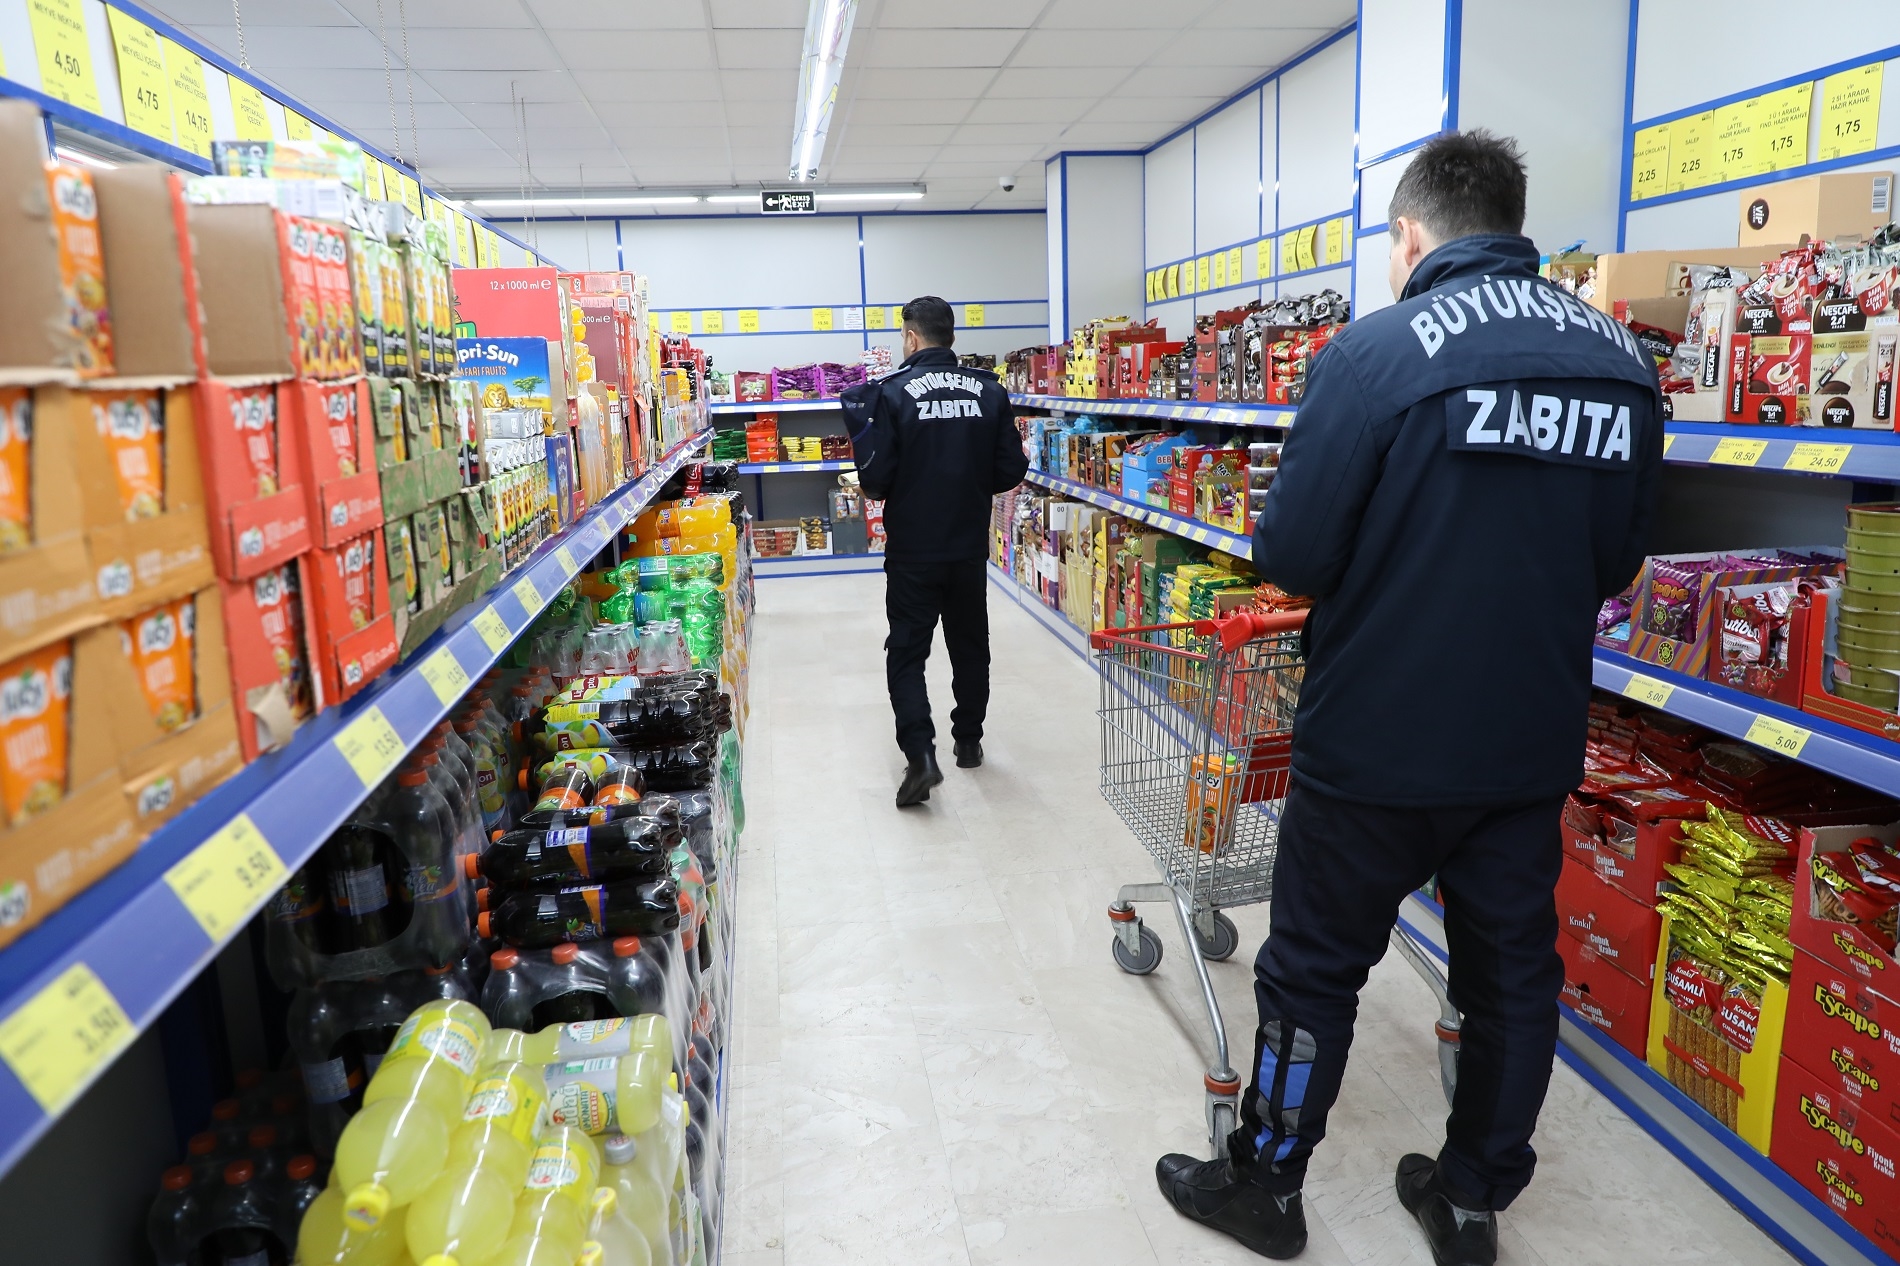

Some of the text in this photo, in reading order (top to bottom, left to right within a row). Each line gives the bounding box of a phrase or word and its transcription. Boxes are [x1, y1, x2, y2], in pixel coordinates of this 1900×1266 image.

[54, 49, 81, 77] 4,50
[137, 86, 159, 110] 4,75
[1847, 87, 1870, 98] ARADA
[1781, 106, 1801, 116] ARADA
[1830, 95, 1871, 111] HAZIR KAHVE
[185, 110, 208, 133] 14,75
[1727, 122, 1743, 131] LATTE
[1773, 116, 1789, 126] HAZIR
[1789, 111, 1808, 121] KAHVE
[1733, 126, 1751, 137] KAHVE
[1835, 119, 1861, 138] 1,75
[1685, 136, 1700, 146] SALEP
[1770, 135, 1793, 153] 1,75
[1722, 147, 1744, 164] 1,75
[1681, 158, 1701, 175] 2,25
[1638, 168, 1656, 184] 2,25
[490, 280, 540, 291] 12 x 1000 ml
[904, 371, 984, 400] BÜYÜKŞEHİR
[916, 400, 983, 420] ZABITA
[1466, 389, 1631, 462] ZABITA
[1731, 451, 1756, 462] 18,50
[1809, 457, 1839, 468] 24,50
[1646, 690, 1664, 703] 5,00
[1775, 736, 1798, 751] 5,00
[1604, 864, 1625, 878] Kraker
[1598, 943, 1619, 958] Kraker
[1667, 972, 1704, 997] SUSAMLI
[1831, 981, 1845, 995] Bifa
[1591, 1013, 1612, 1029] Kraker
[1842, 1075, 1862, 1092] Fiyonk
[1846, 1085, 1863, 1099] Kraker
[1816, 1095, 1830, 1109] Bifa
[1867, 1145, 1895, 1171] Fiyonk
[1873, 1160, 1896, 1180] Kraker
[1828, 1186, 1847, 1206] Fiyonk
[1832, 1198, 1848, 1212] Kraker
